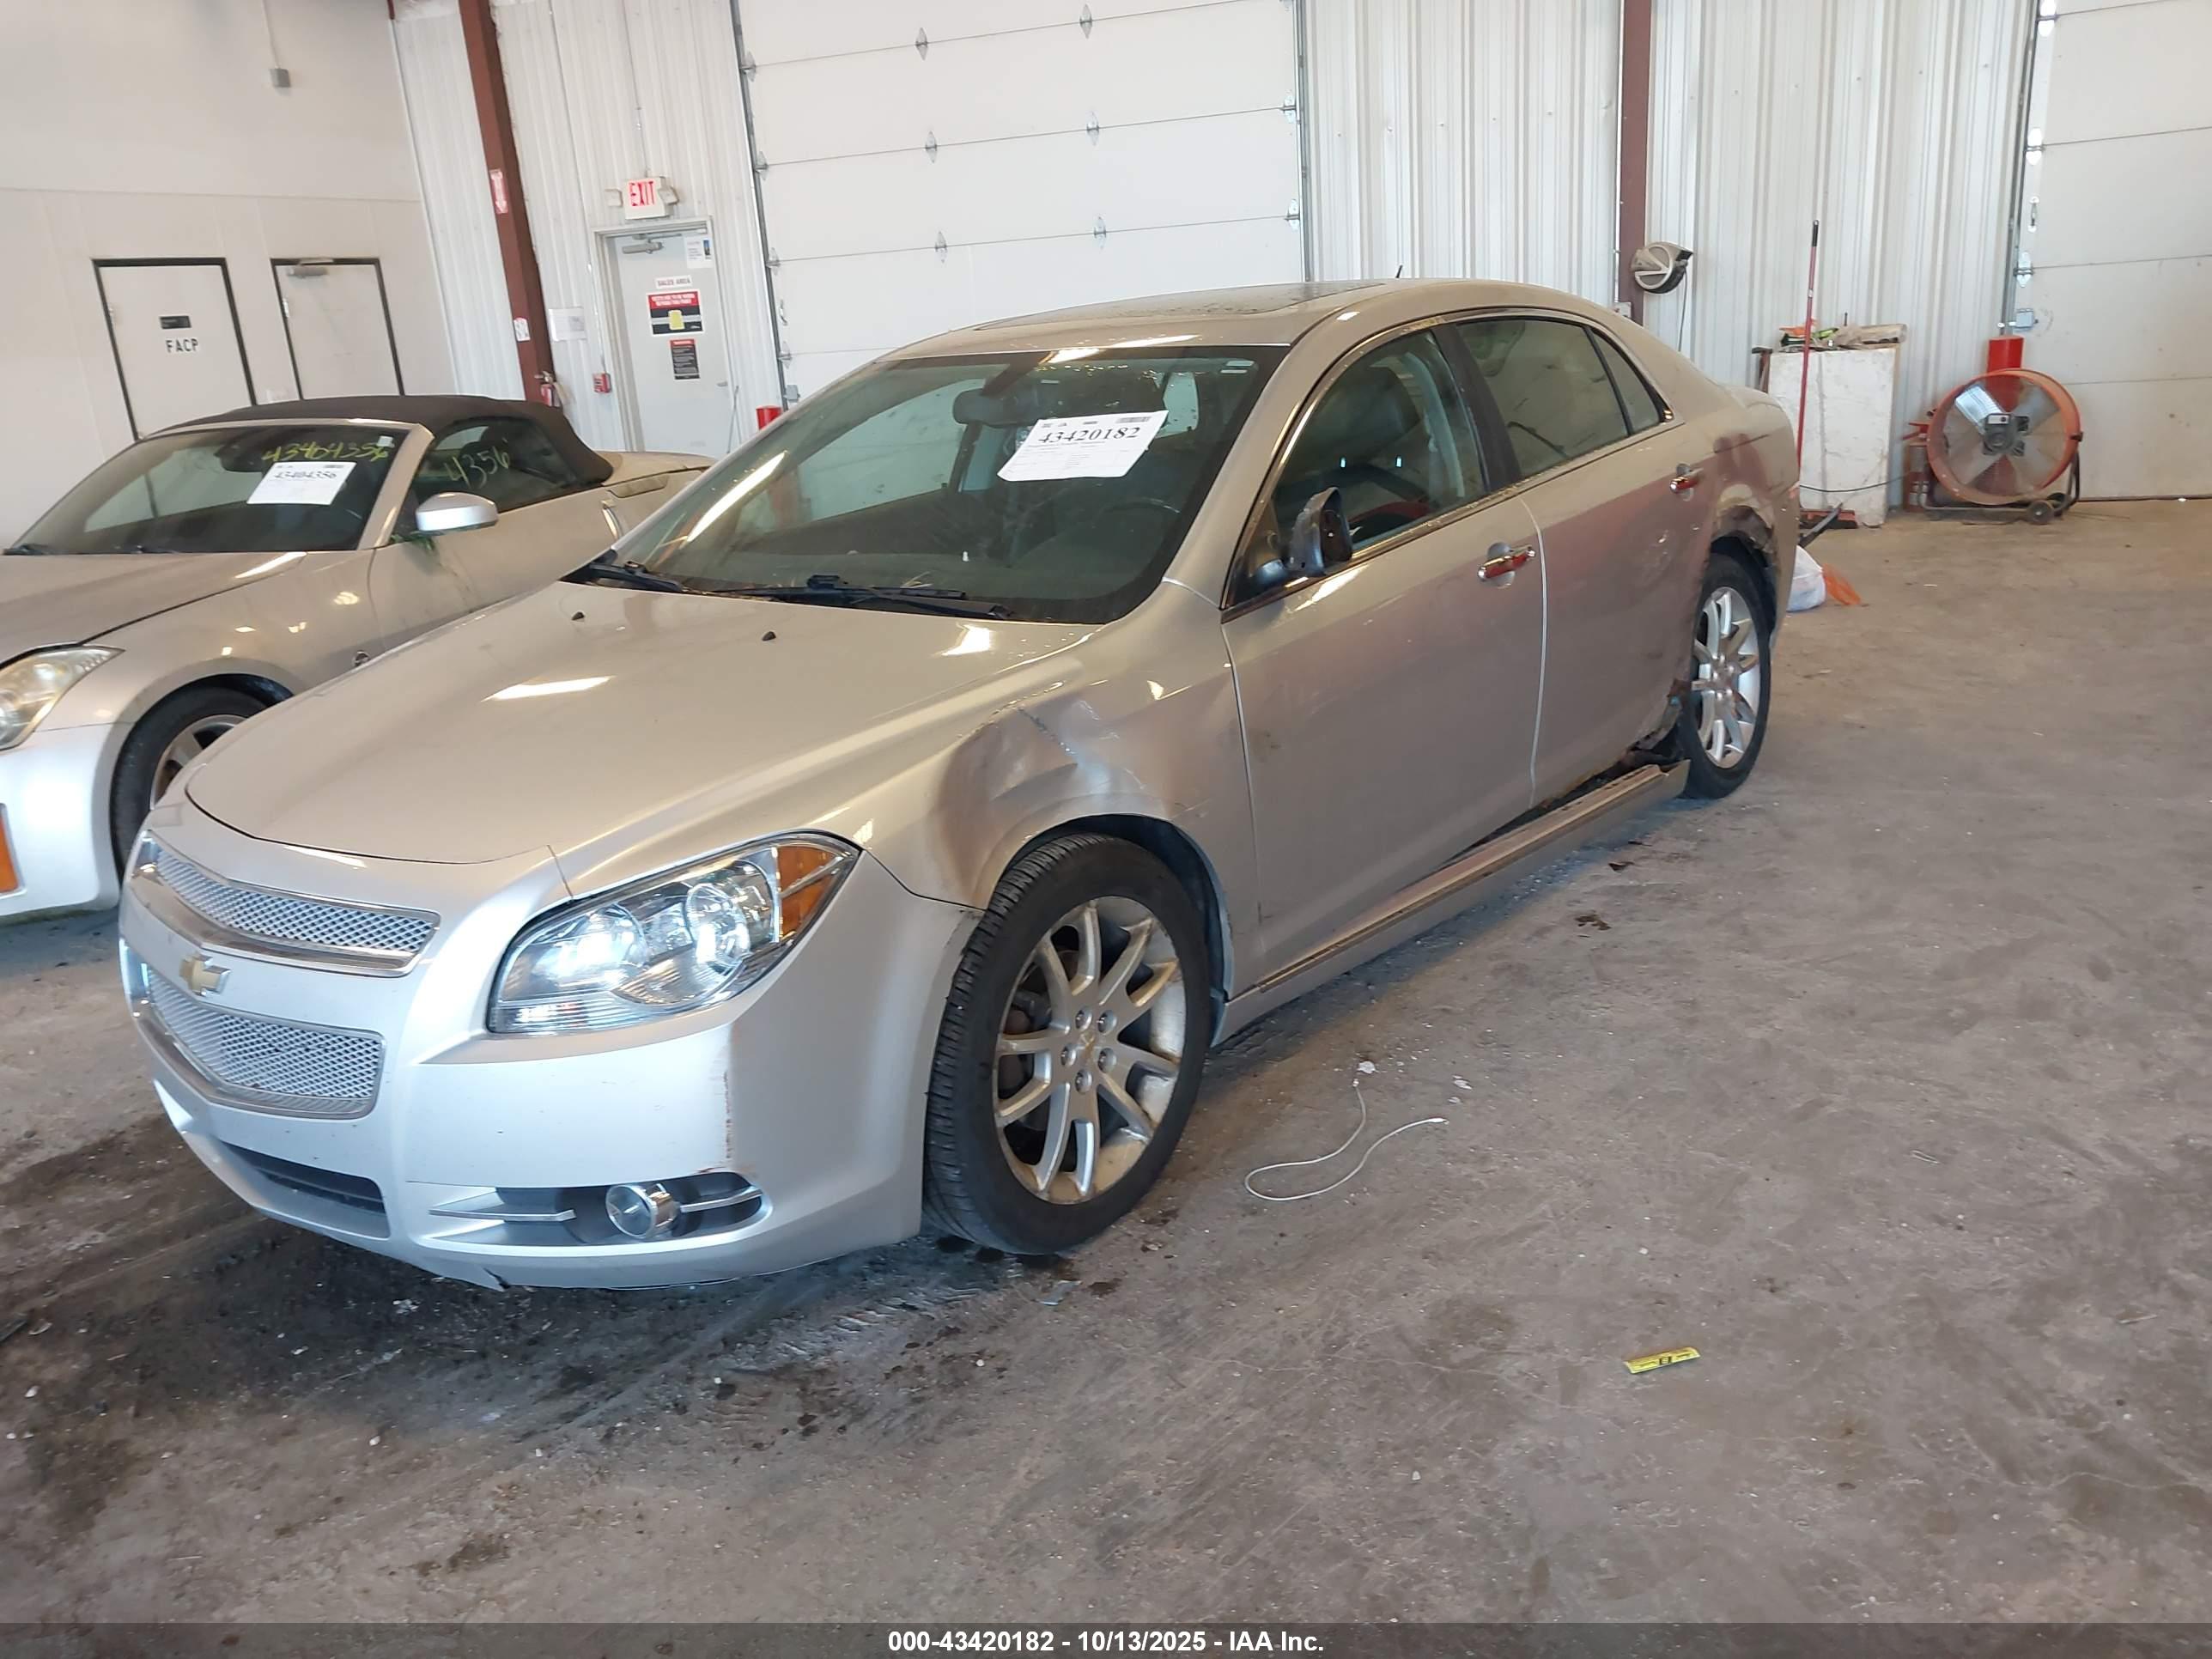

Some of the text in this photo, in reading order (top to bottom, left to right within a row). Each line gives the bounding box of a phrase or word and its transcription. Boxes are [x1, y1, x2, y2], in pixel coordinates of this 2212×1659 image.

[629, 180, 654, 207] EXIT
[165, 338, 198, 353] FACP
[1037, 427, 1141, 444] 43420182
[444, 445, 510, 489] 4356
